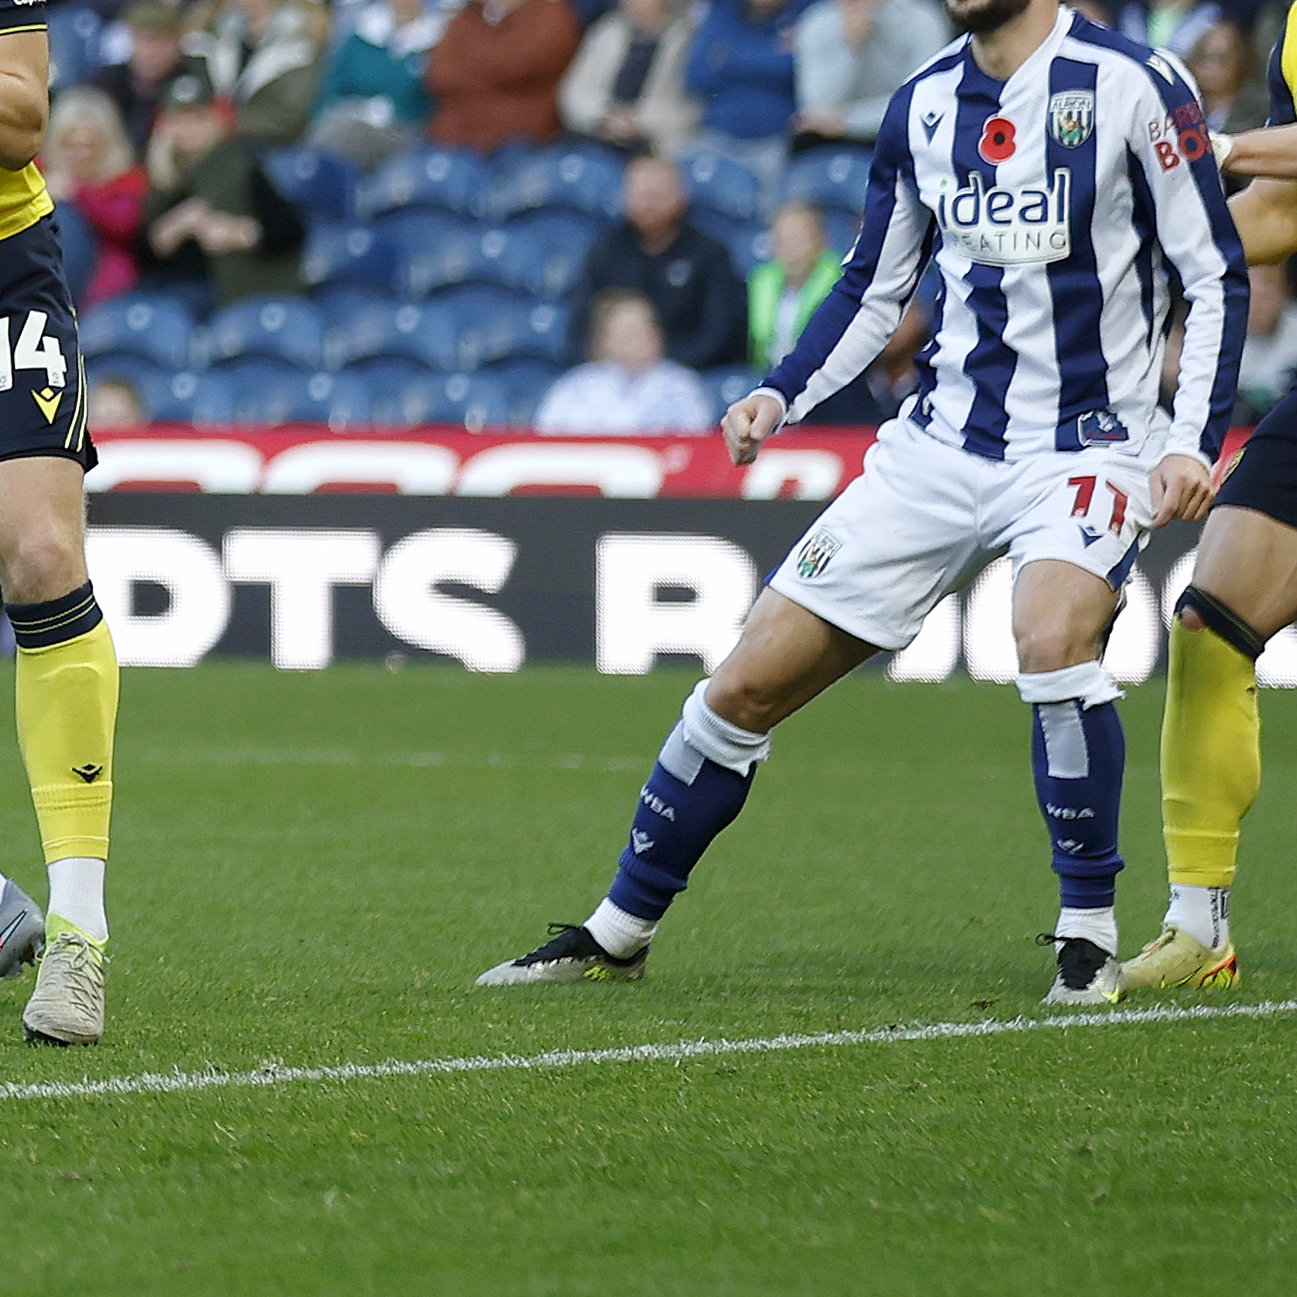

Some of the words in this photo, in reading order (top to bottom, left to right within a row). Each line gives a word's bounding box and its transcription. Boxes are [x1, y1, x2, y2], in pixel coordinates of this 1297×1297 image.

[938, 173, 1066, 230] ideal
[639, 784, 676, 823] WBA
[1045, 802, 1096, 820] WBA
